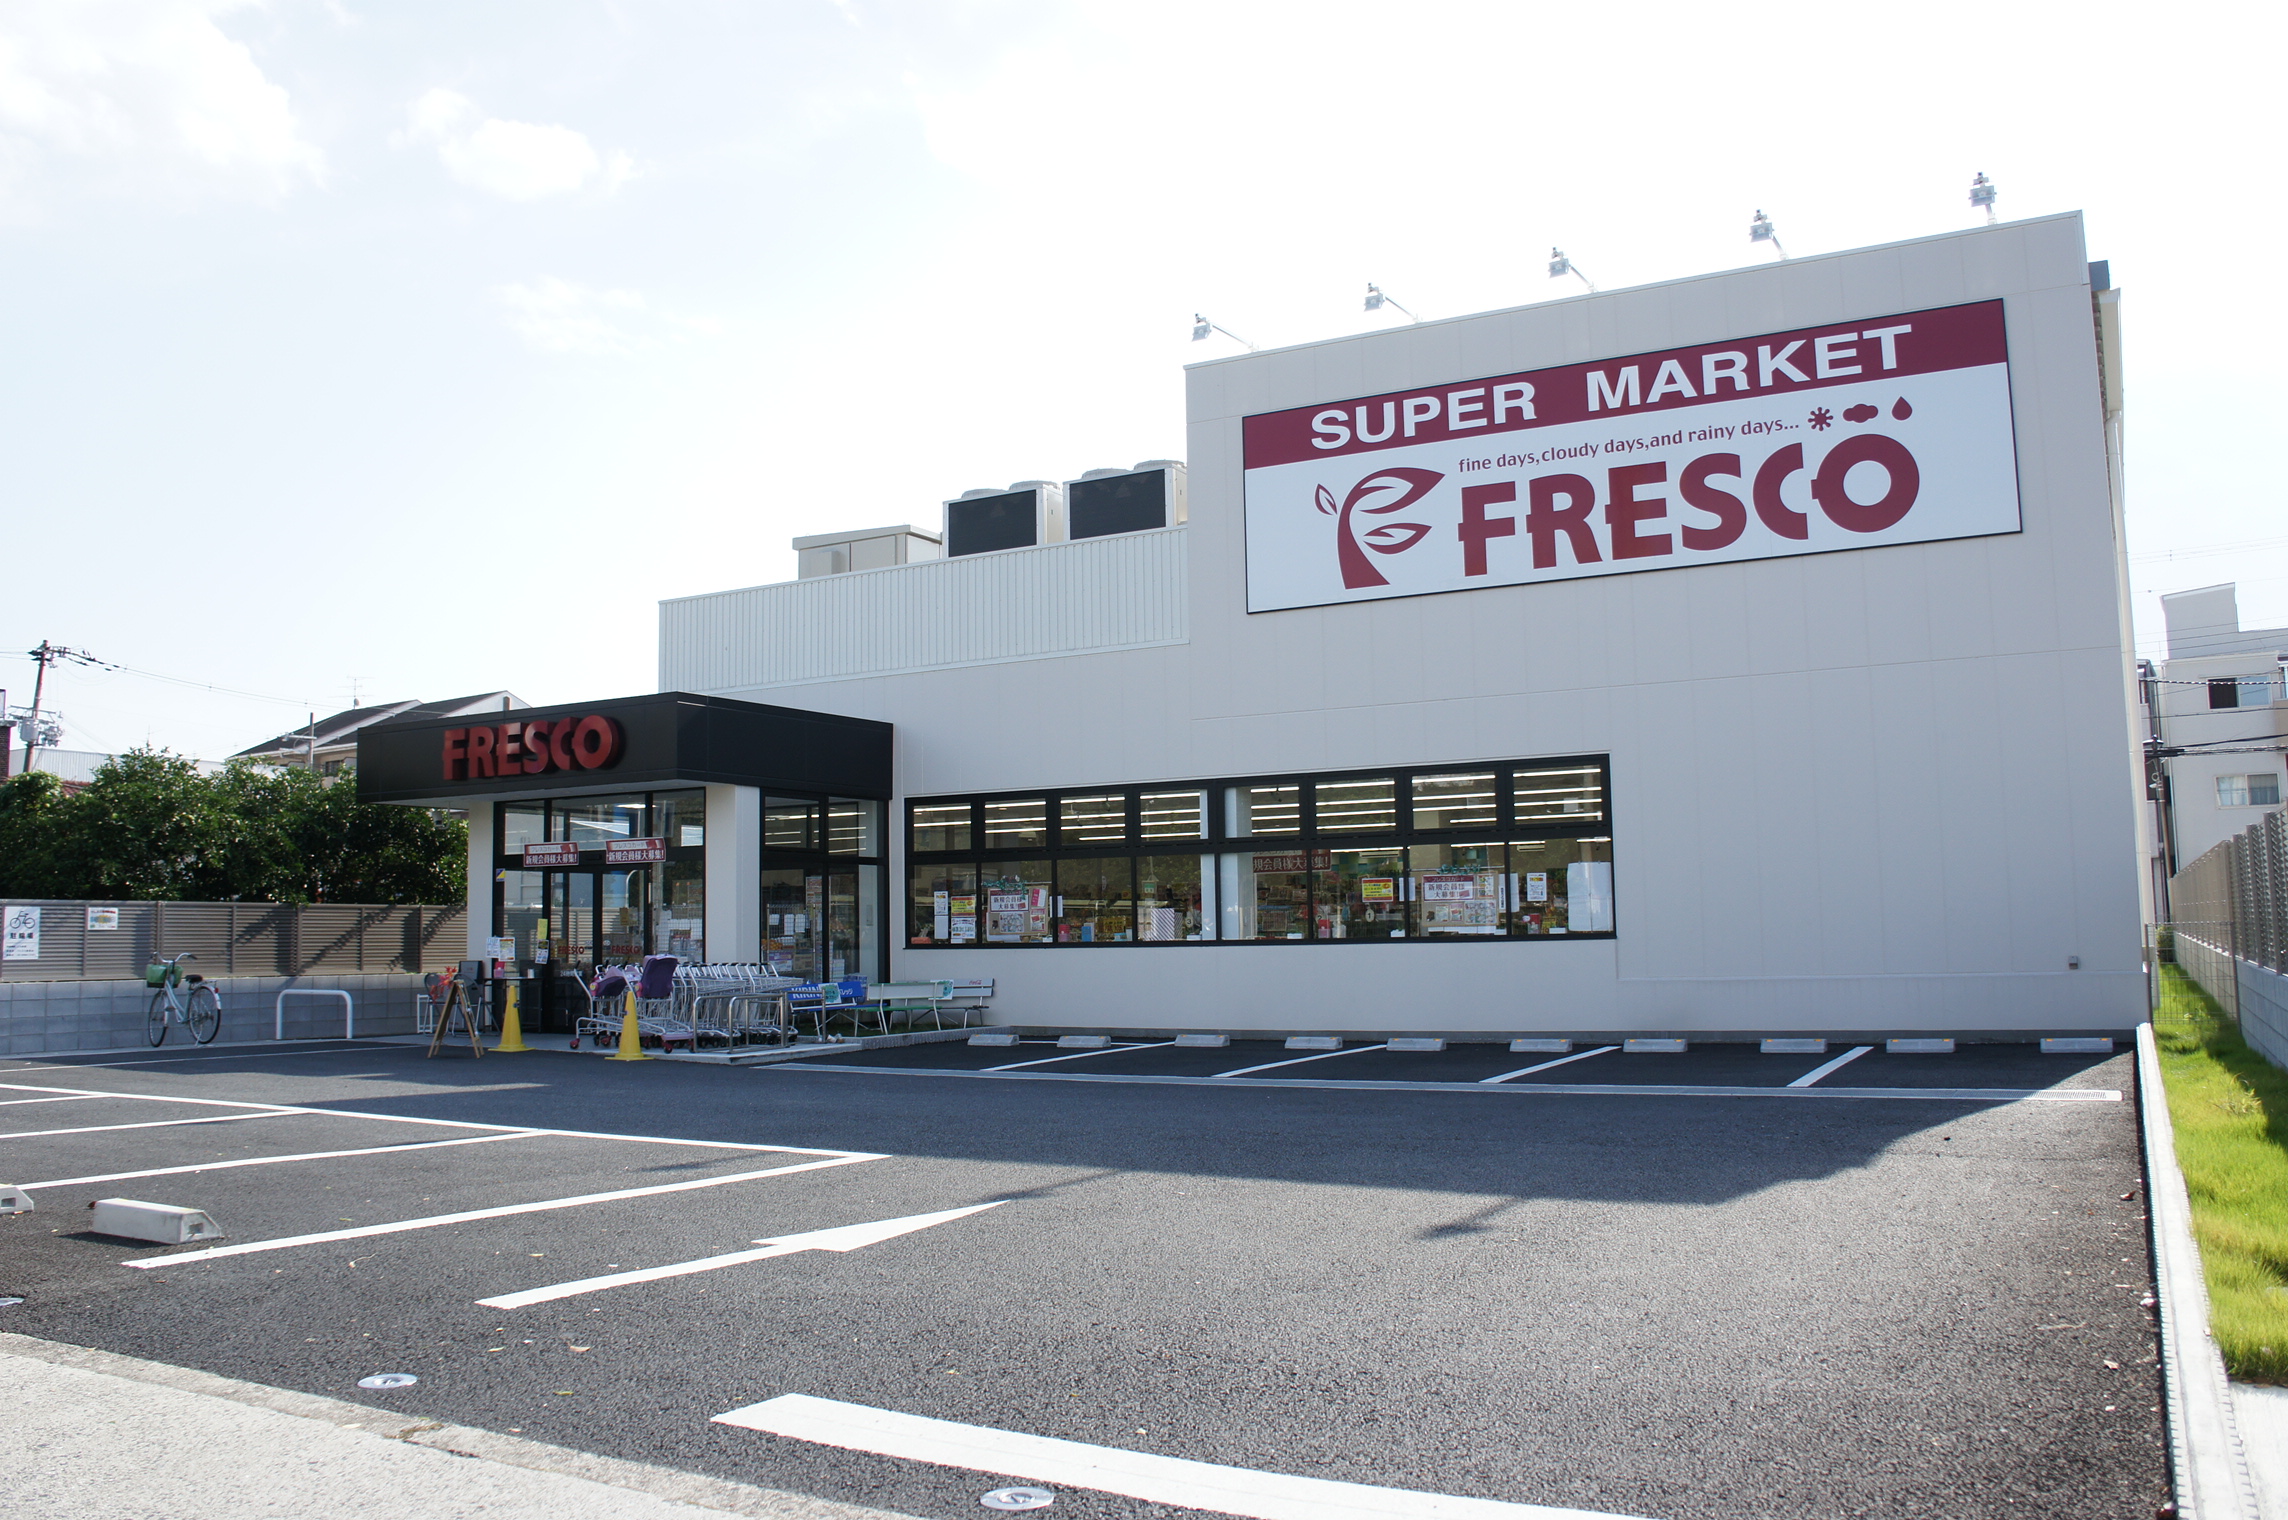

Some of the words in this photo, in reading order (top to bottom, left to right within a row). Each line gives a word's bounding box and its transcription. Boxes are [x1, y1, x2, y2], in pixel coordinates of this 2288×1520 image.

[1311, 381, 1538, 451] SUPER
[1586, 324, 1912, 412] MARKET
[1458, 457, 1492, 473] fine
[1688, 425, 1736, 443] rainy
[1458, 433, 1920, 577] FRESCO
[442, 714, 618, 781] FRESCO
